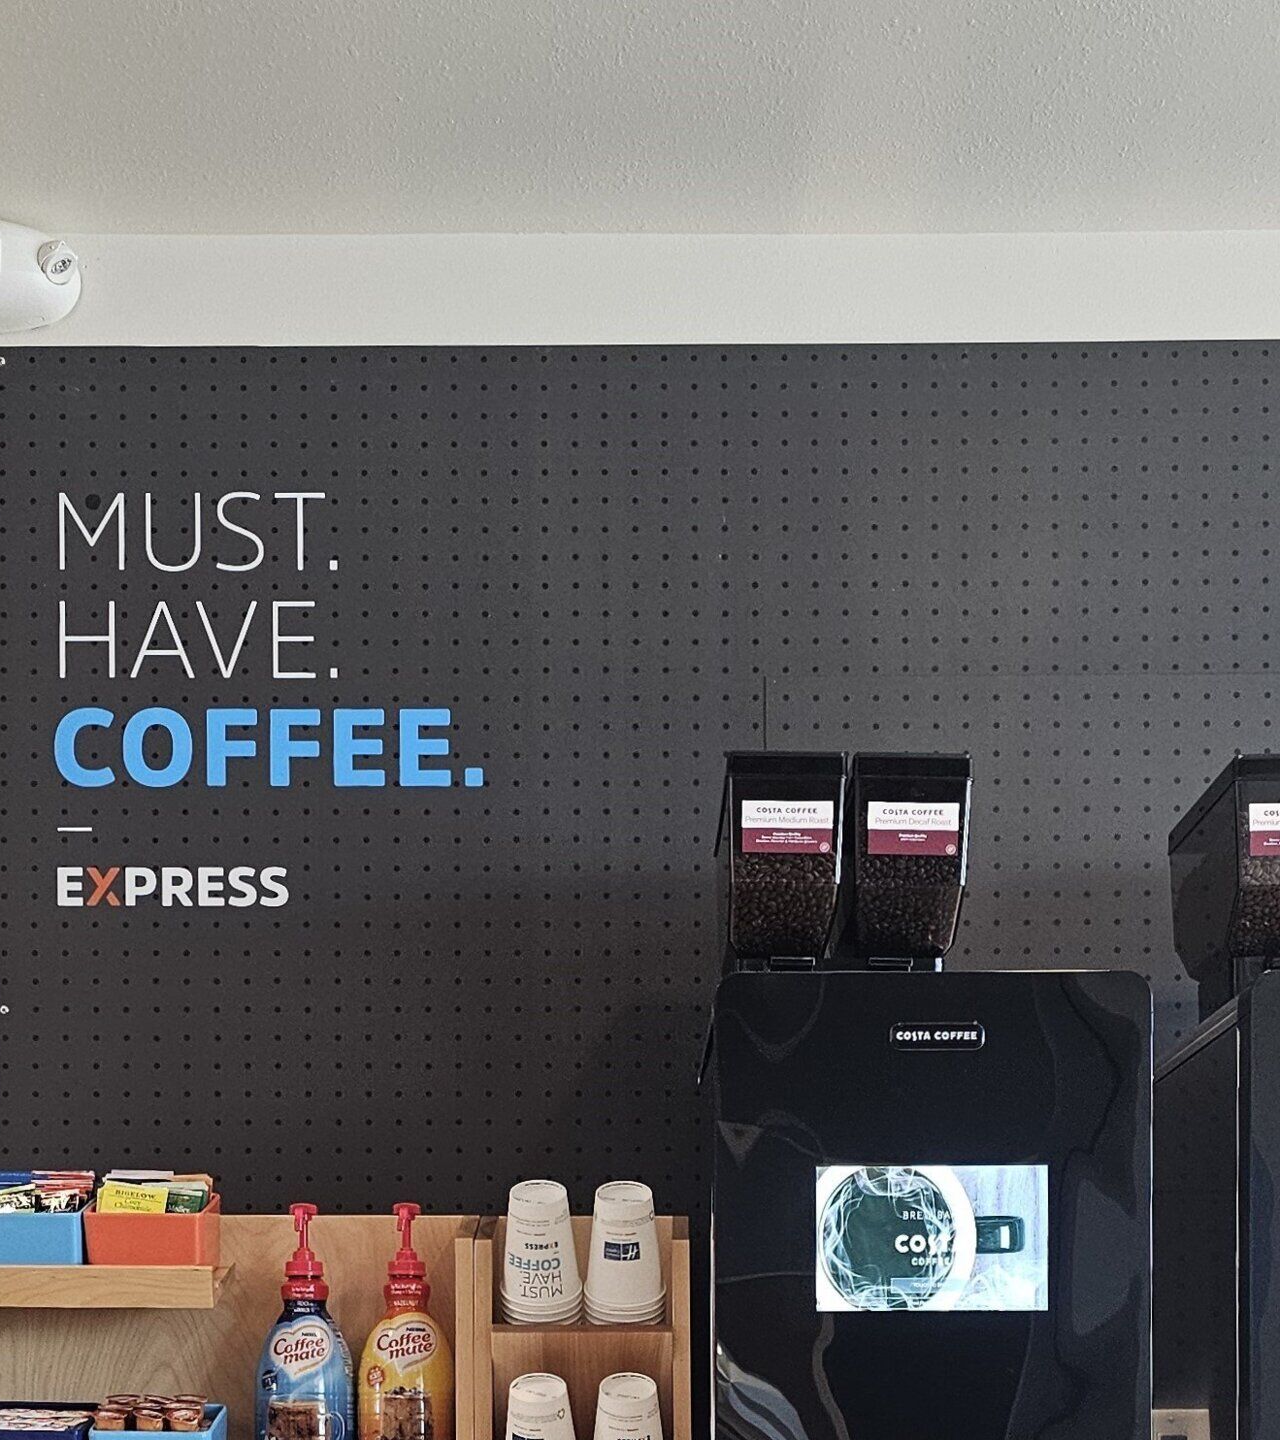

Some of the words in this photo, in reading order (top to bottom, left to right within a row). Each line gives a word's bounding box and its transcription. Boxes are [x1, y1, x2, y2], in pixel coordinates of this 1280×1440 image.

[57, 490, 339, 572] MUST.
[58, 600, 339, 679] HAVE.
[53, 706, 484, 788] COFFEE.
[744, 815, 778, 824] Premium
[882, 808, 908, 816] COSTA
[875, 817, 907, 825] Premium
[56, 866, 289, 907] EXPRESS
[896, 1031, 931, 1042] COSTA
[933, 1031, 978, 1040] COFFEE
[115, 1189, 157, 1200] BIGELOW
[524, 1241, 559, 1250] EXPRESS
[519, 1270, 562, 1285] HAVE.
[519, 1283, 563, 1299] MUST.
[273, 1338, 324, 1356] Coffee
[376, 1333, 431, 1351] Coffee
[283, 1347, 325, 1365] mate
